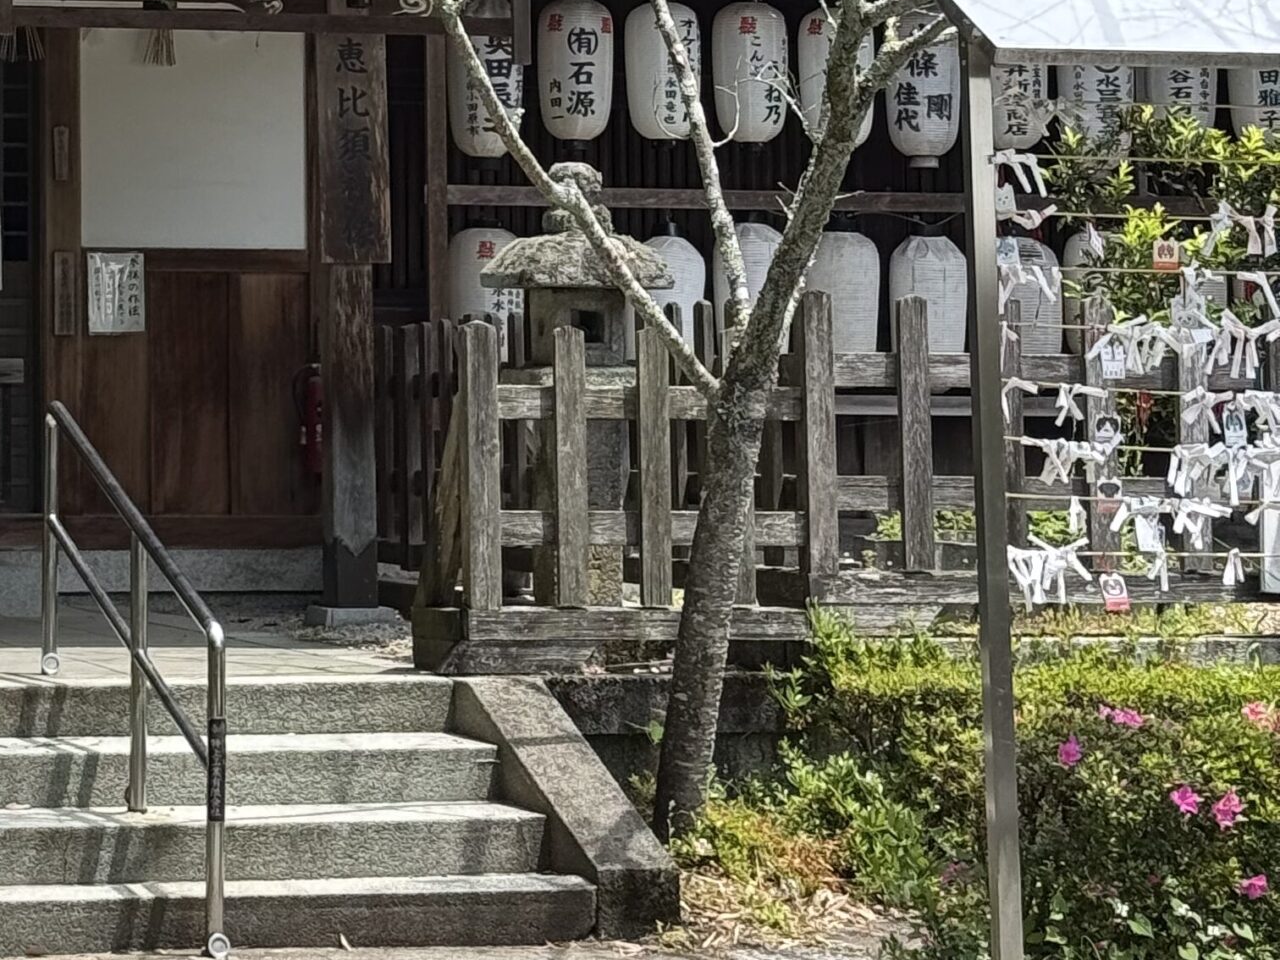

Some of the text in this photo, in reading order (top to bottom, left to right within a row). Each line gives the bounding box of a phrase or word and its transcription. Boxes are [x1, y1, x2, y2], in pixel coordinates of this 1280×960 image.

[549, 78, 564, 121] 内田一
[923, 93, 953, 122] 剛
[336, 37, 372, 250] 恵比須
